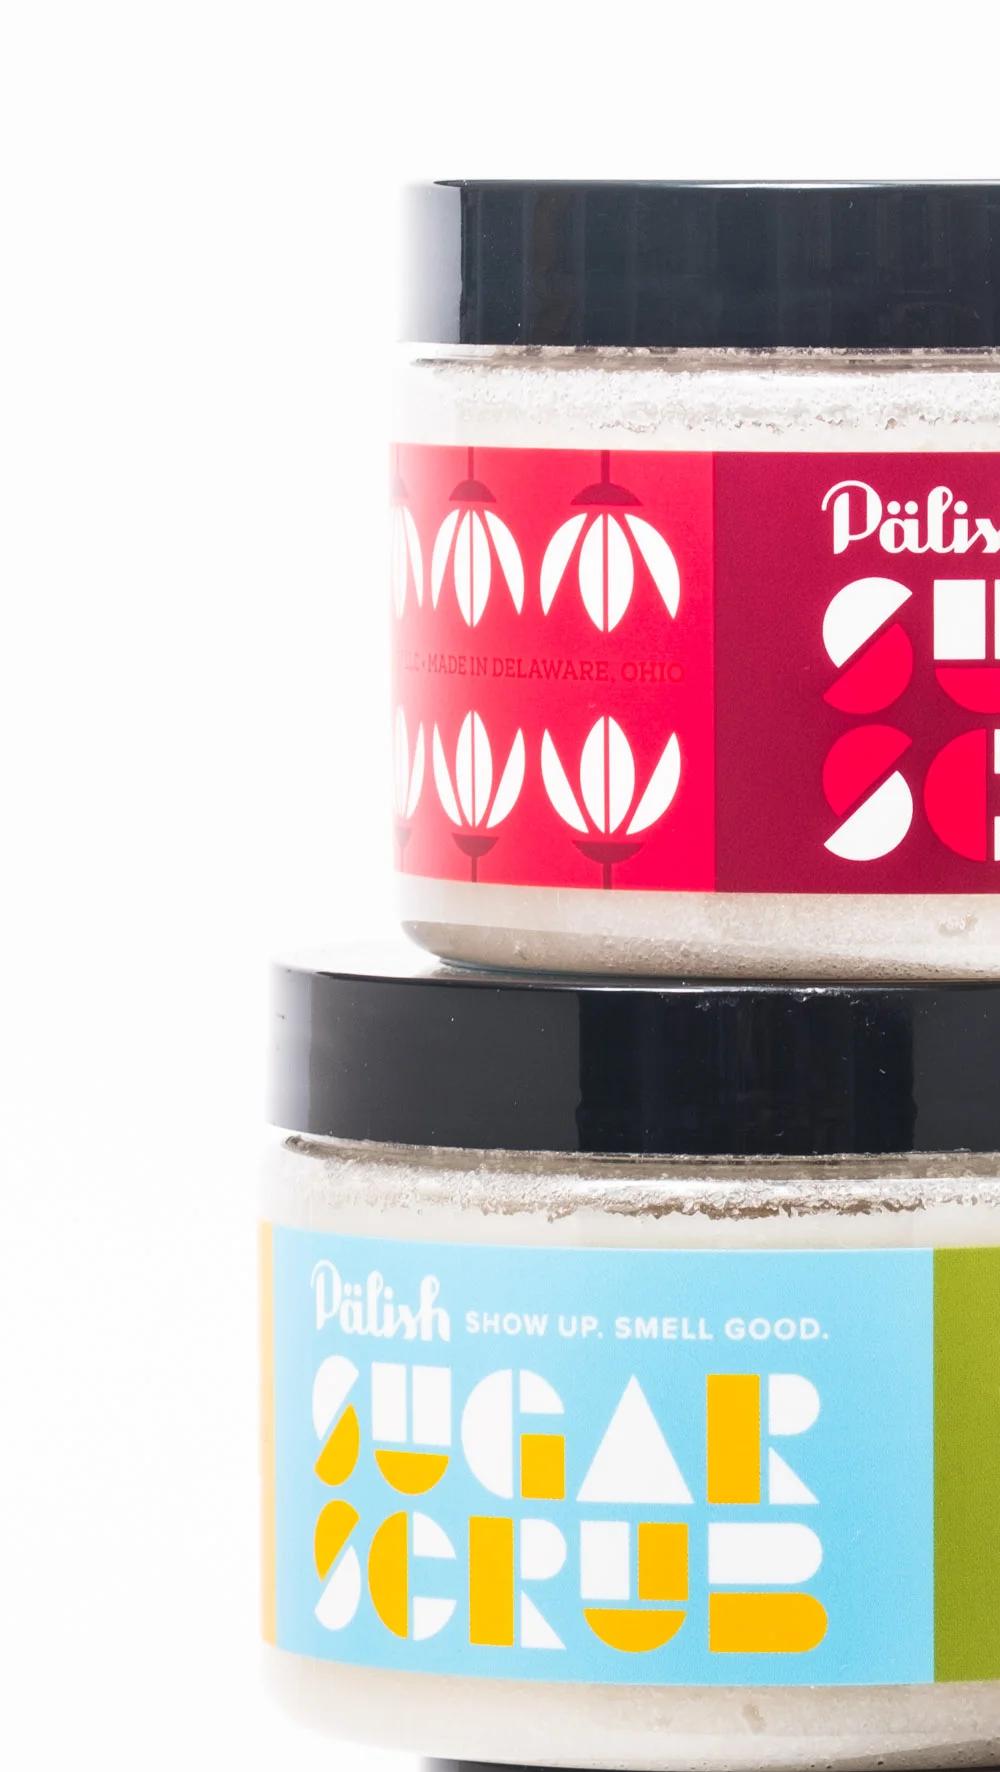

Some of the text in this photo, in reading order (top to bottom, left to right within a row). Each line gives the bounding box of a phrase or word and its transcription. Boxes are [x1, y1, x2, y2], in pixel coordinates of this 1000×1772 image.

[427, 653, 467, 676] MADE
[470, 655, 488, 676] IN
[492, 657, 616, 684] DELAWARE,
[620, 661, 684, 683] OHIO
[311, 1259, 450, 1342] Pälish
[466, 1311, 828, 1340] SHOW UP. SMELL GOOD.
[312, 1354, 820, 1505] SUGAR
[313, 1499, 828, 1654] SCRUB
